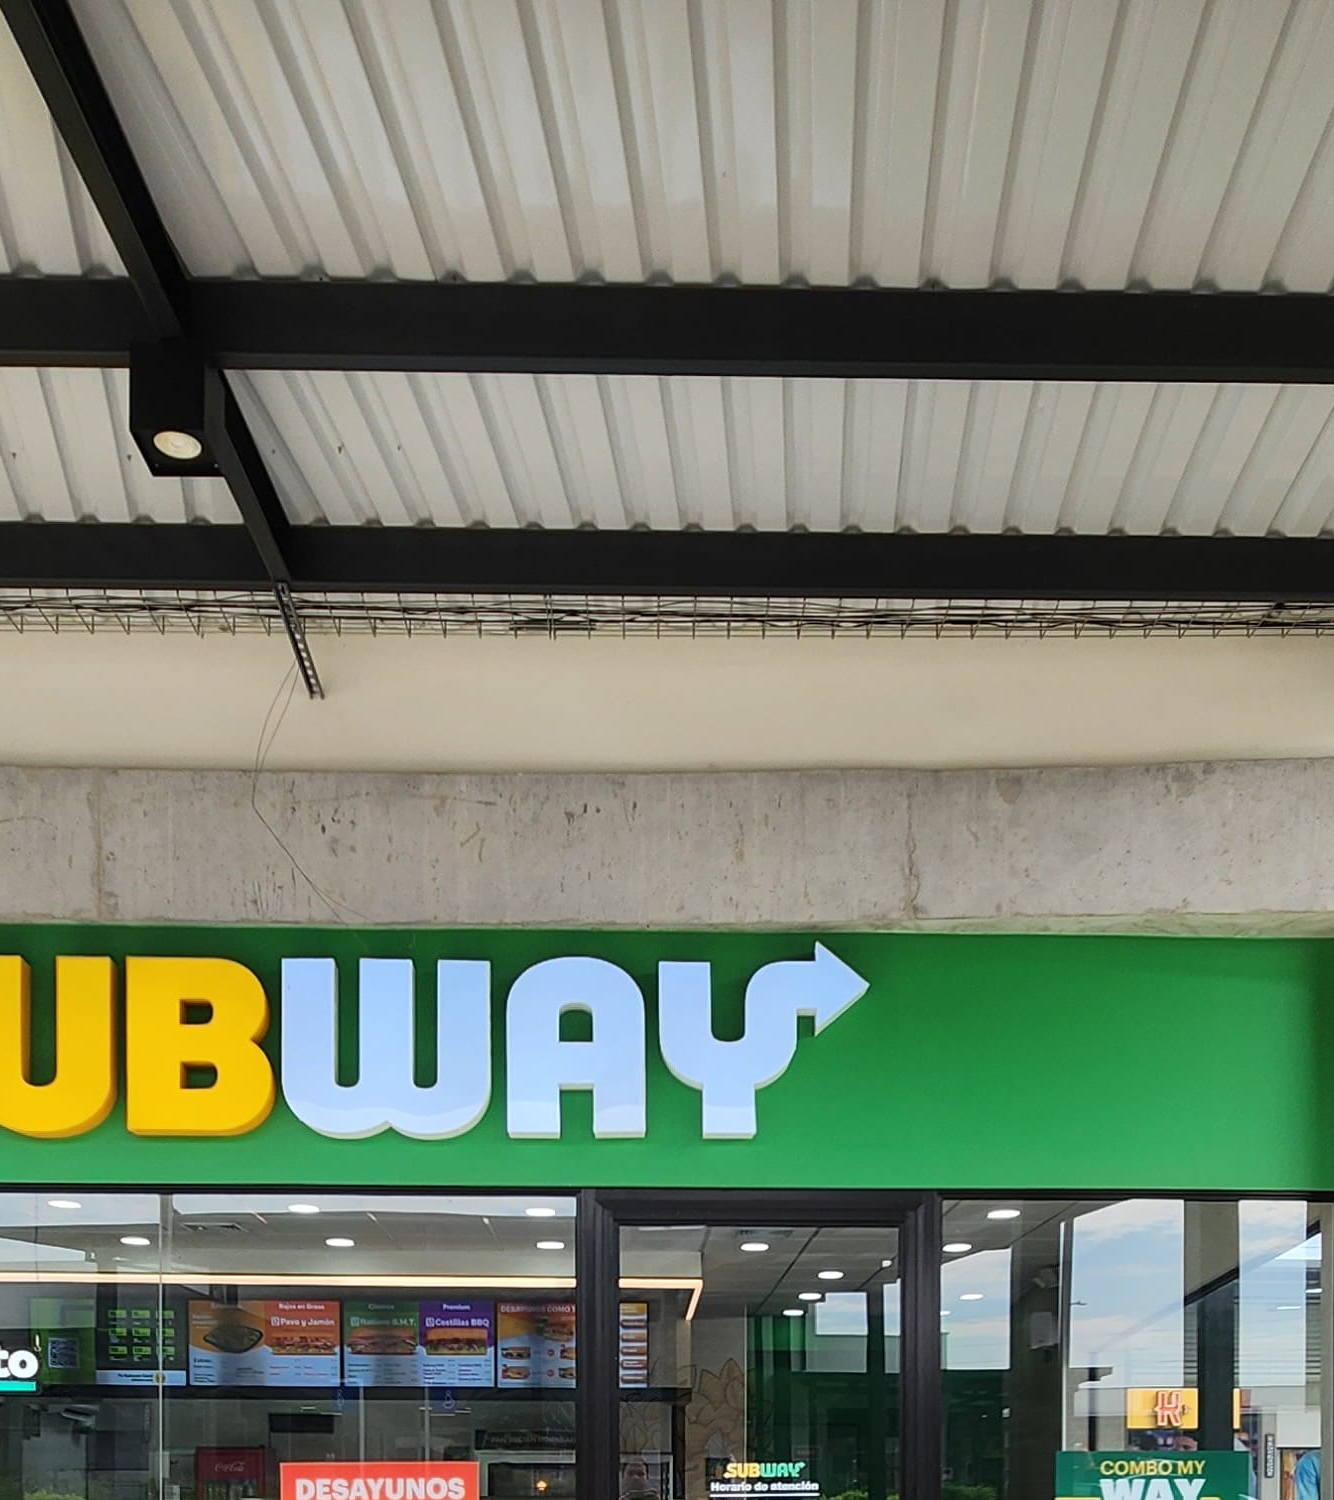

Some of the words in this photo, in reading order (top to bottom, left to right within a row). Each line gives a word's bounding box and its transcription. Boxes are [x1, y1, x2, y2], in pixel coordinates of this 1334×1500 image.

[723, 1461, 806, 1479] SUBWAY
[1099, 1460, 1172, 1475] COMBO
[1177, 1460, 1206, 1475] MY
[295, 1477, 466, 1500] DESAYUNOS
[710, 1482, 752, 1492] Horario
[754, 1482, 768, 1492] de
[770, 1481, 820, 1491] atención
